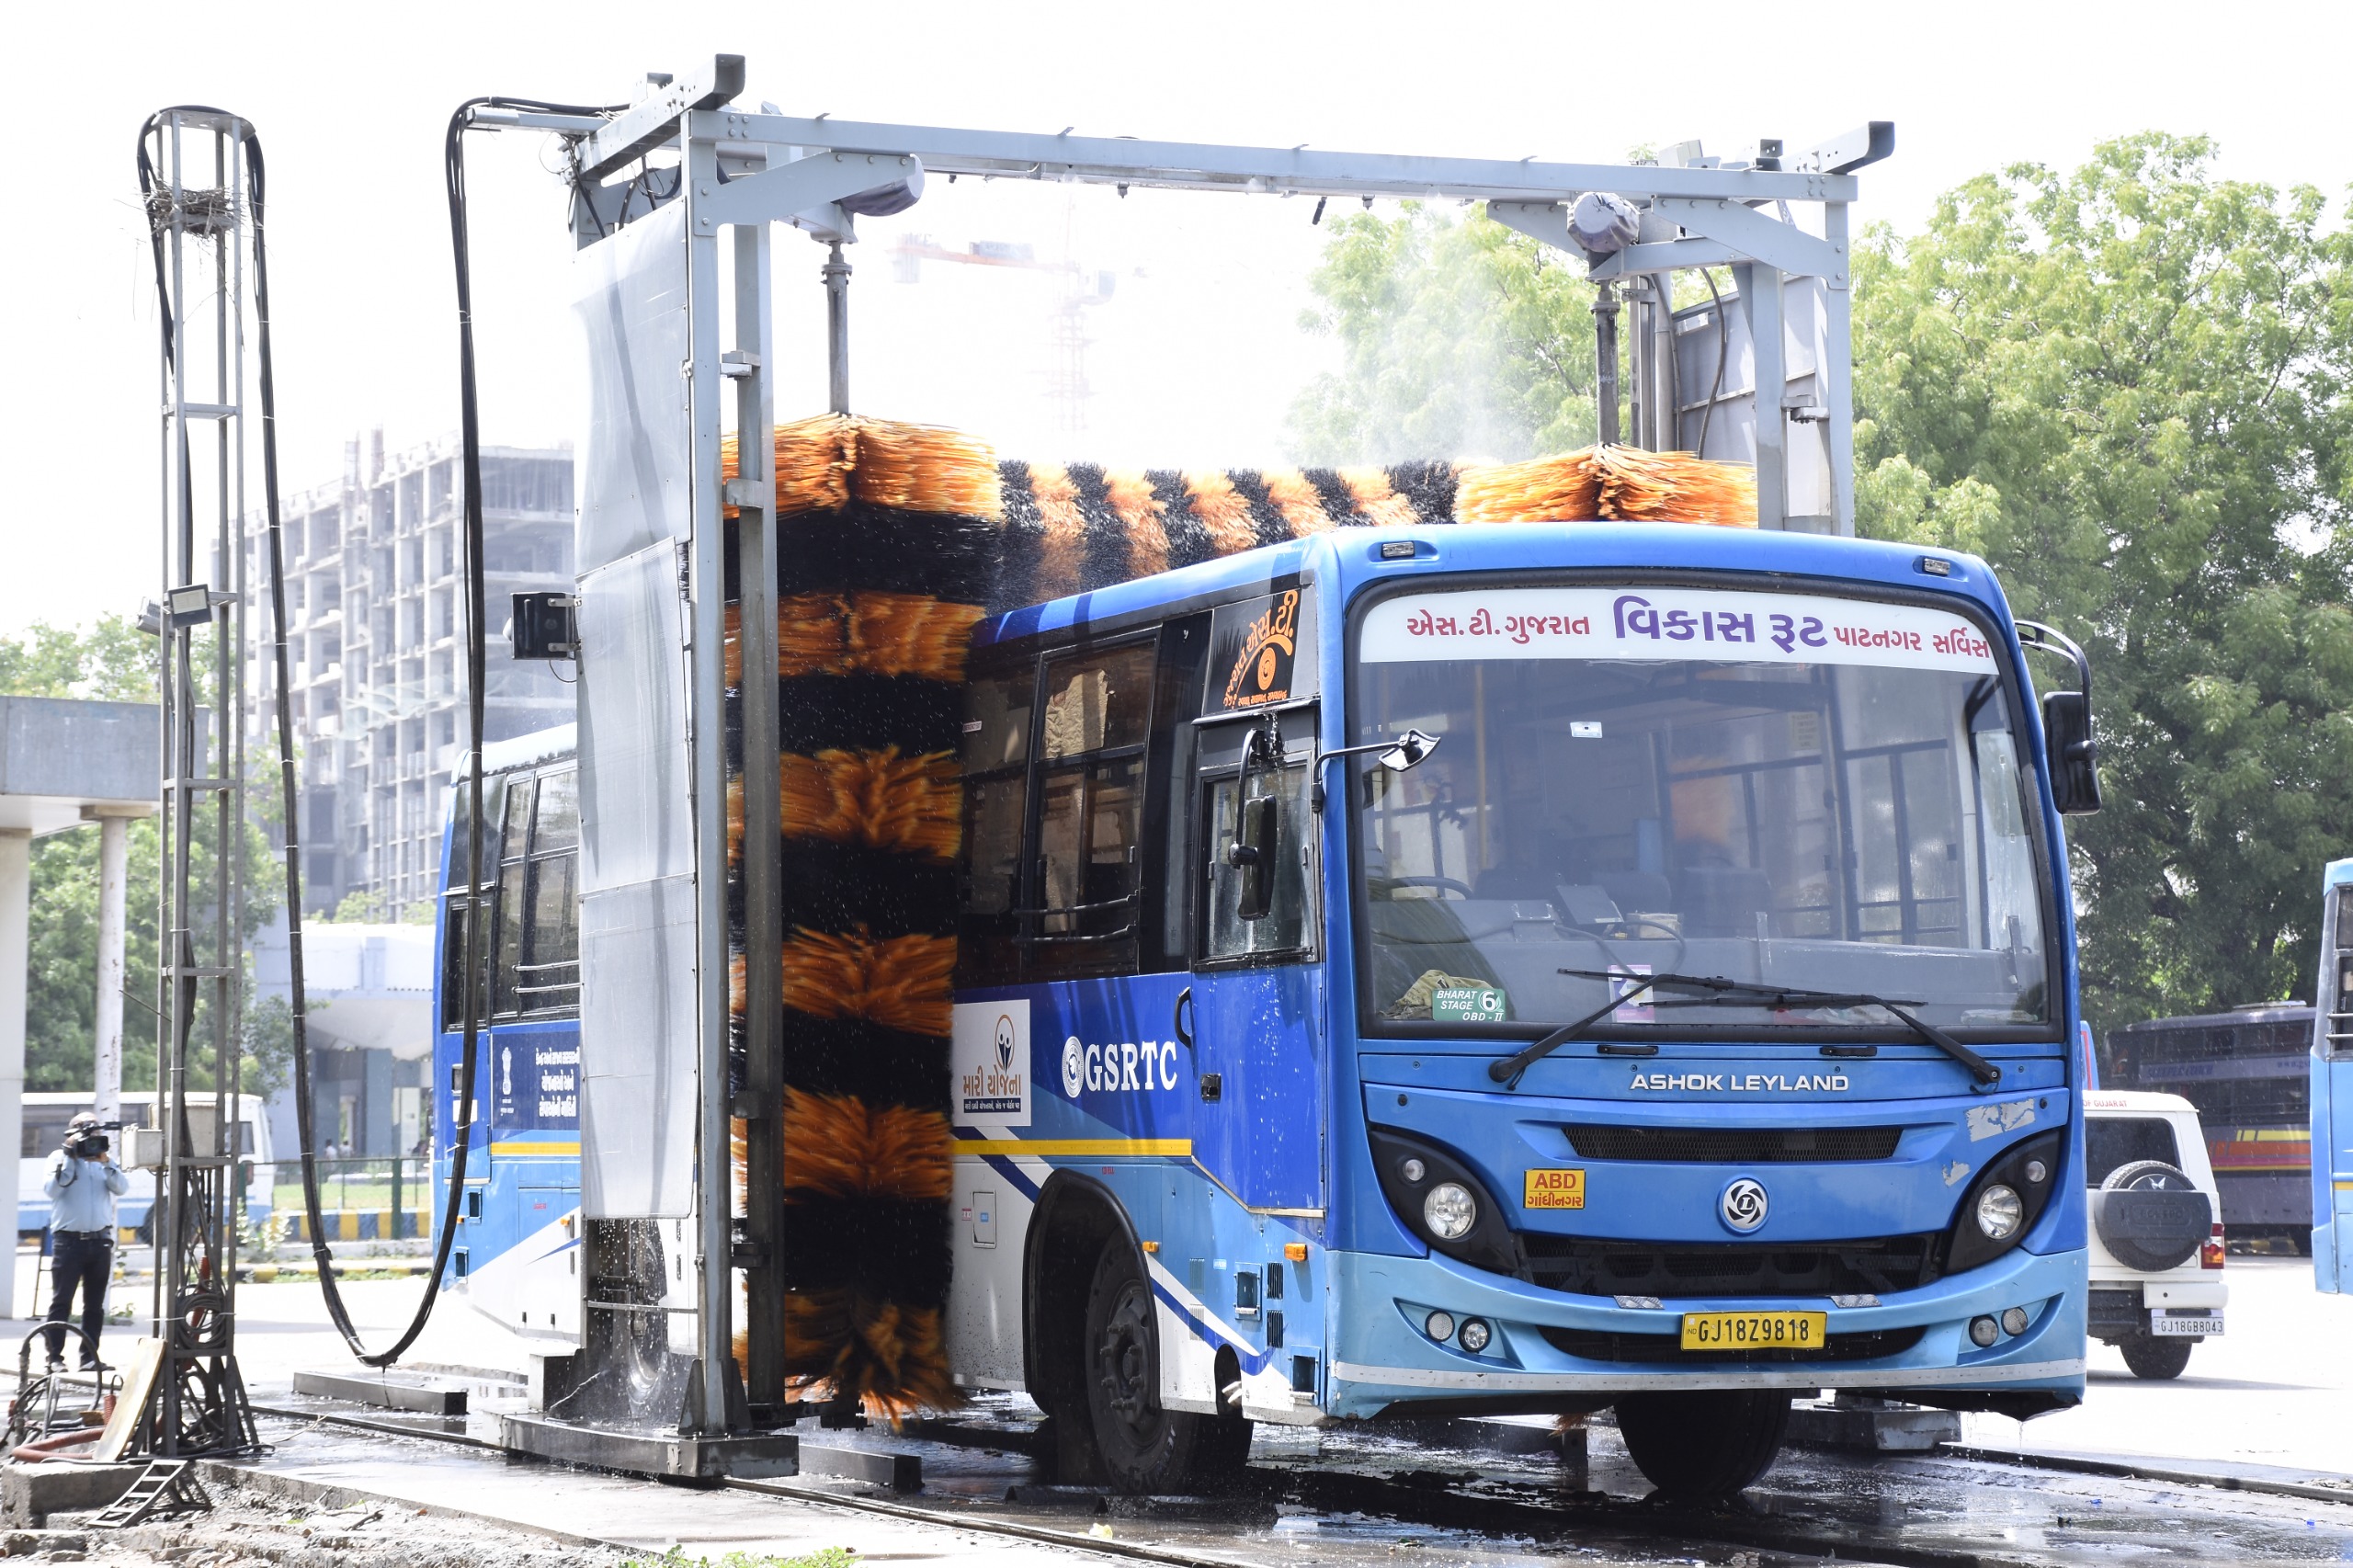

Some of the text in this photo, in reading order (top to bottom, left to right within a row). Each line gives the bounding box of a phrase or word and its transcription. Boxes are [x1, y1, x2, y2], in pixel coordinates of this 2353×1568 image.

[1613, 596, 1756, 642] વિકાસ
[1769, 614, 1828, 653] રૂટ
[1833, 627, 1922, 651] પાટનગર
[1933, 627, 1990, 658] સર્વિસ
[1437, 991, 1478, 999] BHARAT
[1482, 991, 1496, 1011] 6
[1441, 1001, 1474, 1010] STAGE
[1462, 1013, 1486, 1021] OBD
[1085, 1040, 1177, 1091] GSRTC
[963, 1064, 1021, 1096] મારી યોજના
[1630, 1074, 1849, 1091] ASHOK LEYLAND
[2093, 1099, 2128, 1108] GUJARAT
[1534, 1173, 1576, 1188] ABD
[1528, 1192, 1582, 1207] ગાંધીનગર
[1739, 1197, 1754, 1210] L
[1699, 1318, 1809, 1343] GJ18Z9818
[2160, 1320, 2223, 1333] GJ18GB8043
